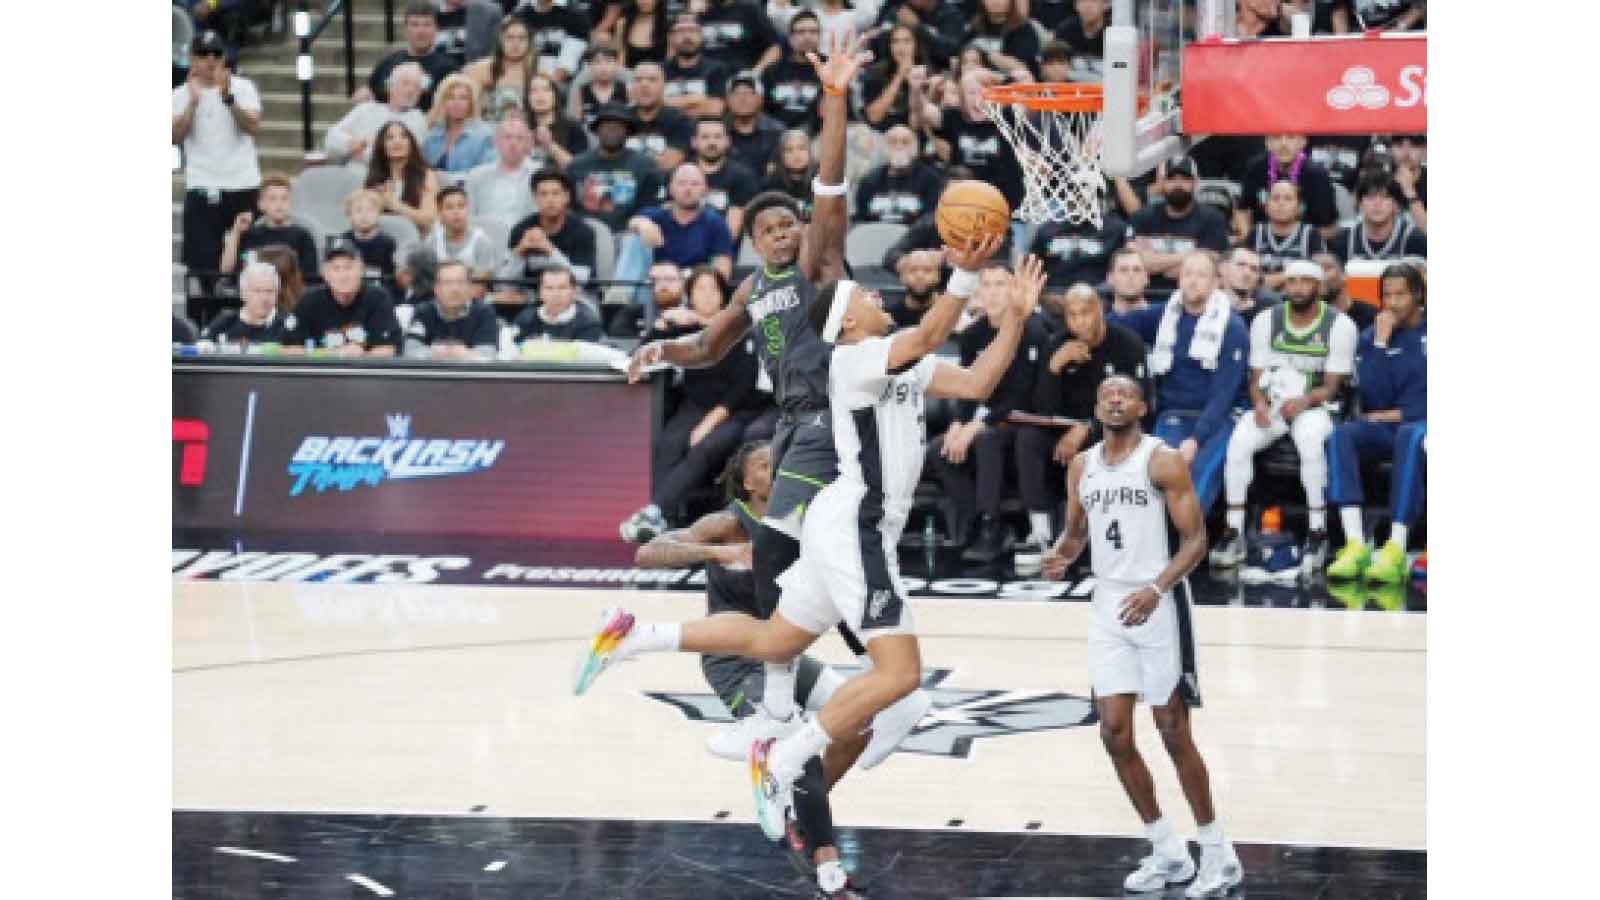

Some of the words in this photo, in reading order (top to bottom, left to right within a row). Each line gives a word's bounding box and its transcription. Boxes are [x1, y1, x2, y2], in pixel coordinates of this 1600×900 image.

[1393, 64, 1427, 108] S
[292, 436, 504, 478] BACKLASH
[1105, 519, 1123, 549] 4
